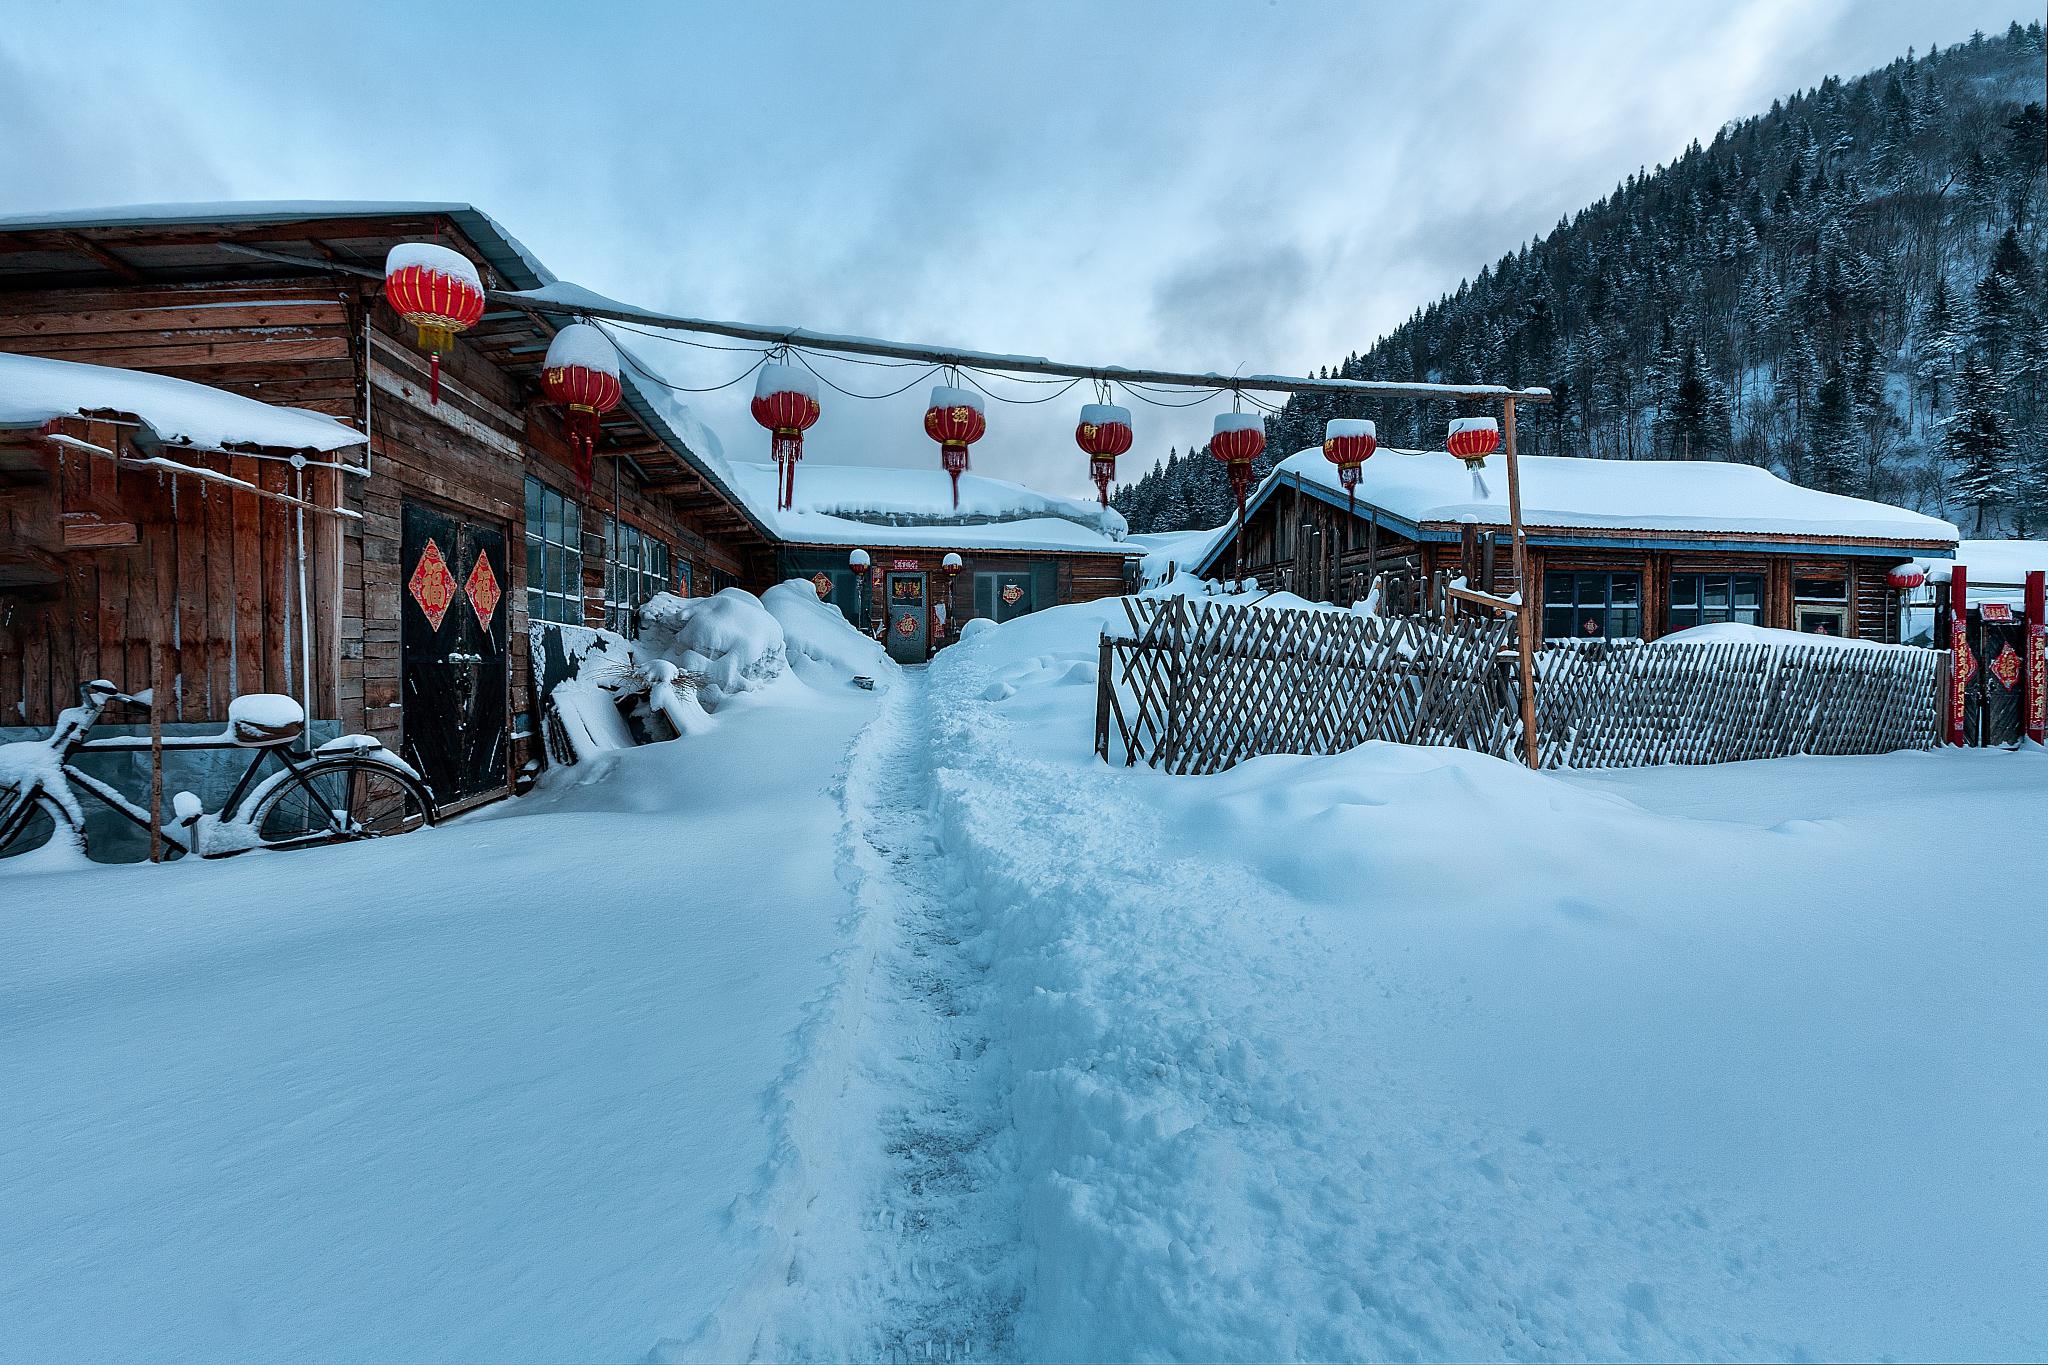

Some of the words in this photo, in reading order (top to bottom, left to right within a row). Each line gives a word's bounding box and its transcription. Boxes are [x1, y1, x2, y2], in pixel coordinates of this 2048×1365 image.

[1083, 425, 1098, 440] 財
[421, 559, 446, 609] 福
[475, 567, 493, 612] 福
